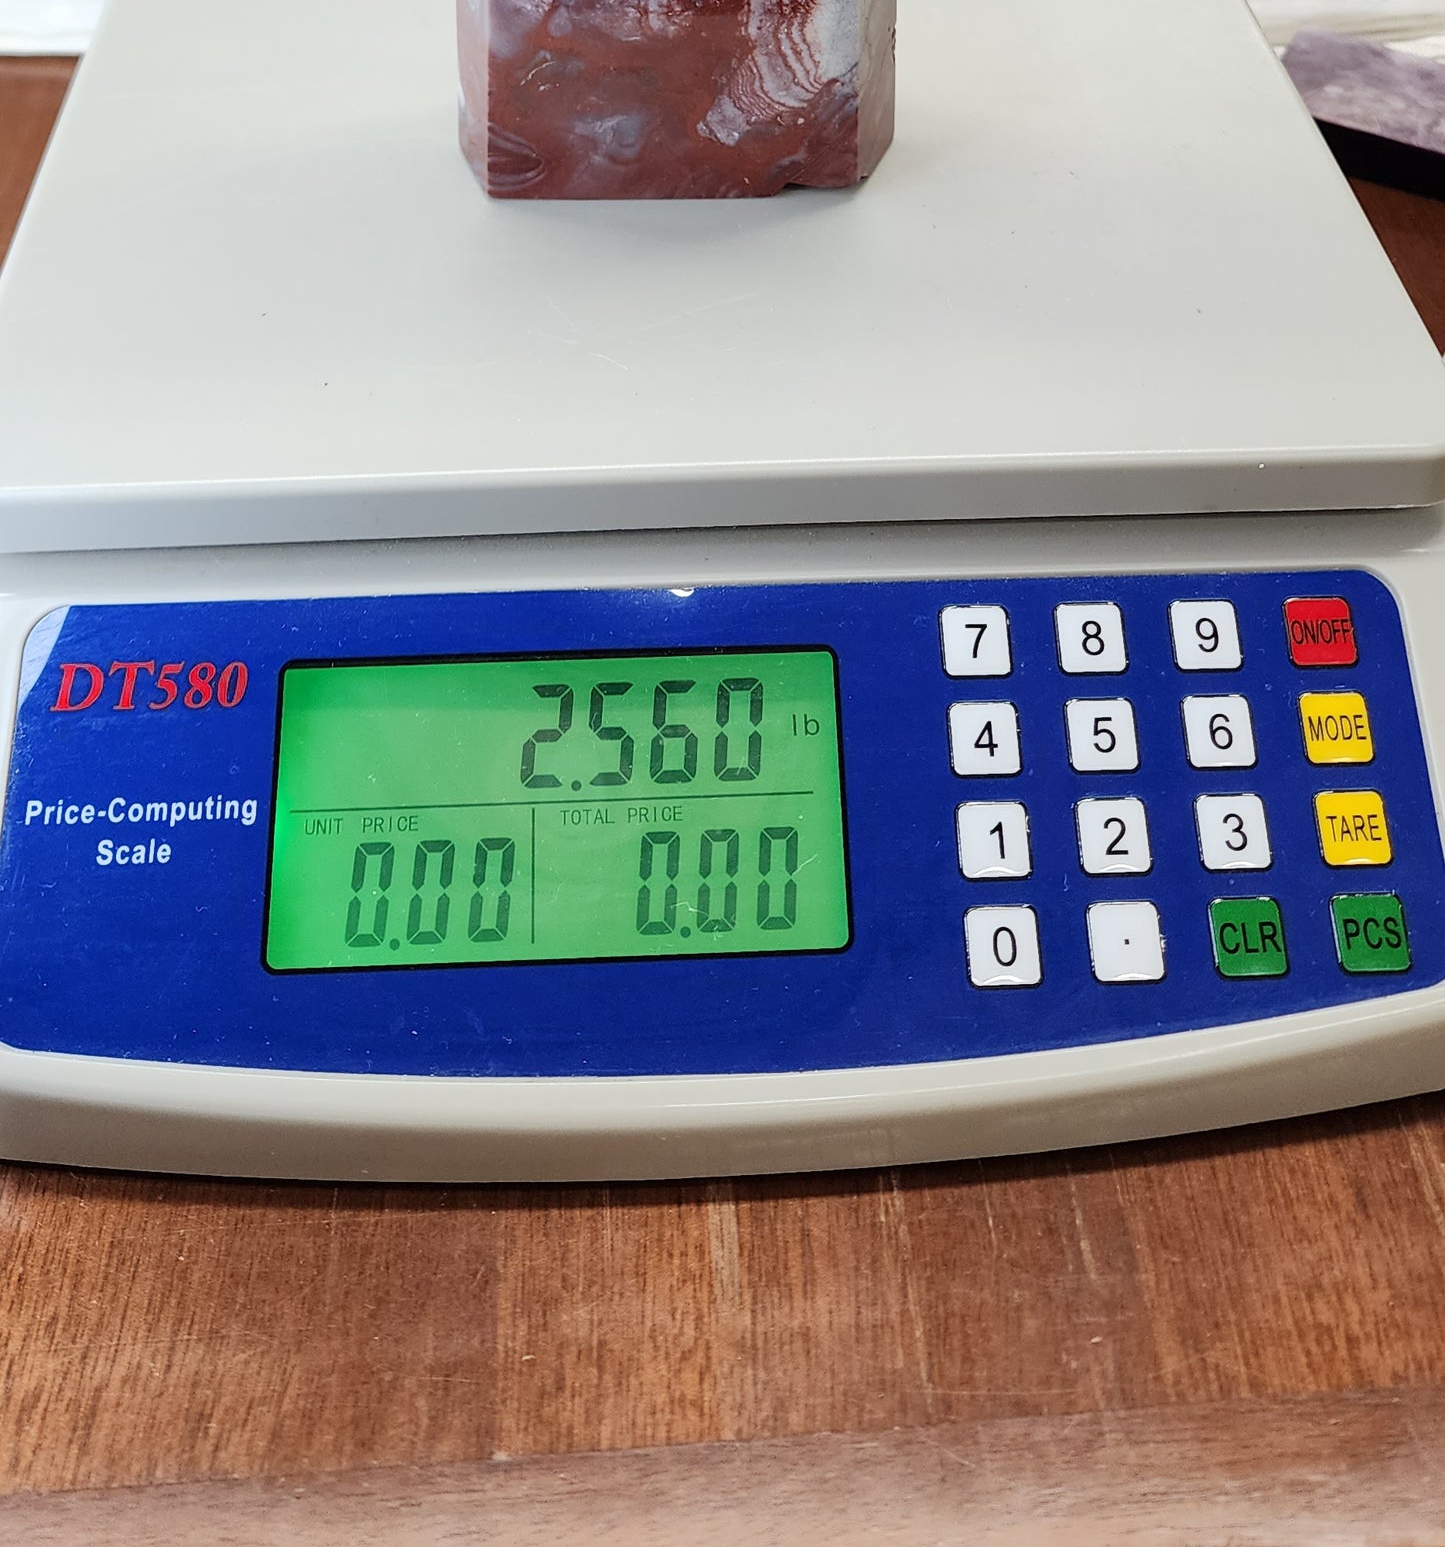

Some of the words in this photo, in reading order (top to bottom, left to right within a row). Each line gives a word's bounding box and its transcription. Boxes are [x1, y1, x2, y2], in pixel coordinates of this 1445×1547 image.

[964, 623, 988, 659] 7
[1080, 620, 1106, 656] 8
[1194, 617, 1220, 653] 9
[1290, 617, 1354, 647] ON/OFF
[49, 659, 250, 713] DT580
[519, 676, 765, 792] 2.560
[790, 712, 821, 738] lb
[973, 720, 999, 757] 4
[1092, 716, 1117, 753] 5
[1208, 713, 1234, 751] 6
[1307, 714, 1369, 742] MODE
[24, 794, 259, 827] Price-Computing
[303, 815, 344, 836] UNIT
[361, 814, 420, 834] PRICE
[559, 806, 616, 826] TOTAL
[626, 804, 684, 824] PRICE
[988, 821, 1007, 860] 1
[1103, 818, 1130, 857] 2
[1222, 813, 1249, 852] 3
[1324, 814, 1384, 844] TARE
[95, 838, 173, 867] Scale
[344, 836, 517, 952] 0.00
[635, 825, 800, 940] 0.00
[991, 926, 1018, 967] 0
[1218, 920, 1283, 955] CLR
[1343, 916, 1403, 951] PCS
